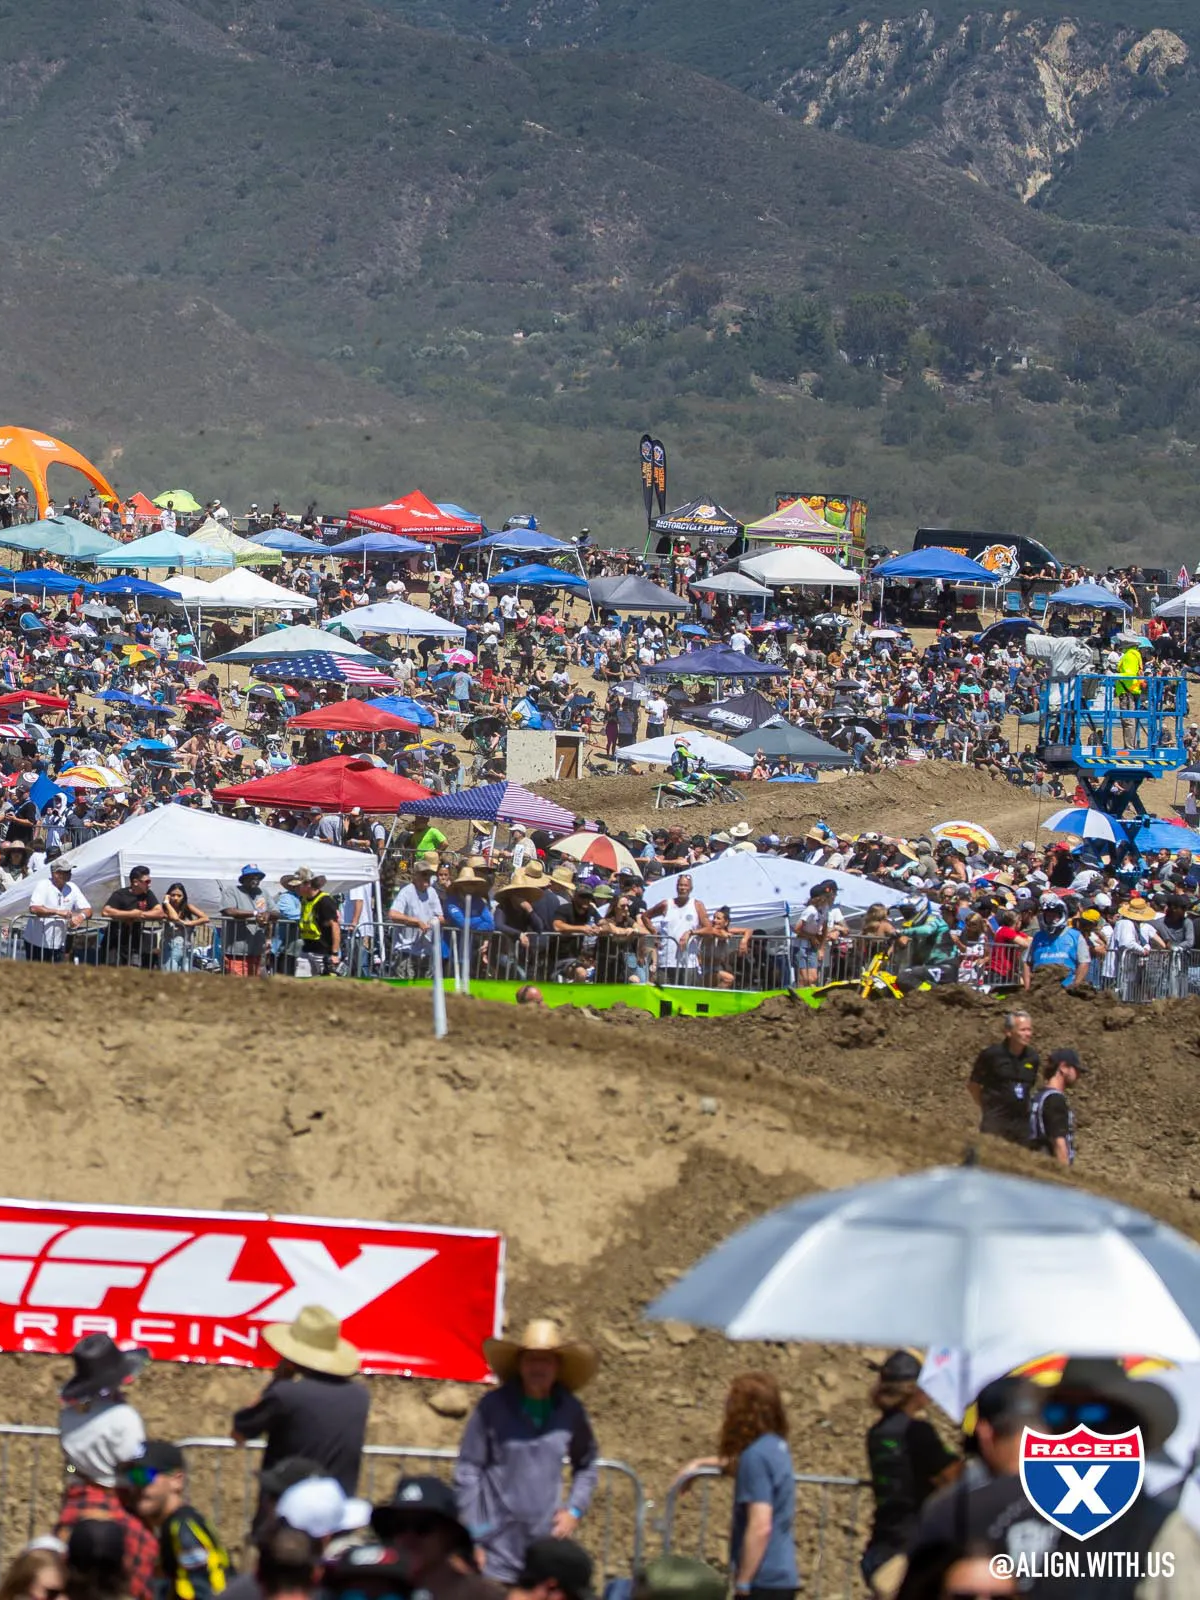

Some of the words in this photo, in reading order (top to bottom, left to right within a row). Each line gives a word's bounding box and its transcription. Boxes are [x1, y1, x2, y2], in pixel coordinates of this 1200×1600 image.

[656, 520, 703, 531] MOTORCYCLE
[703, 524, 738, 534] LAWYERS
[14, 1310, 258, 1347] RACIN
